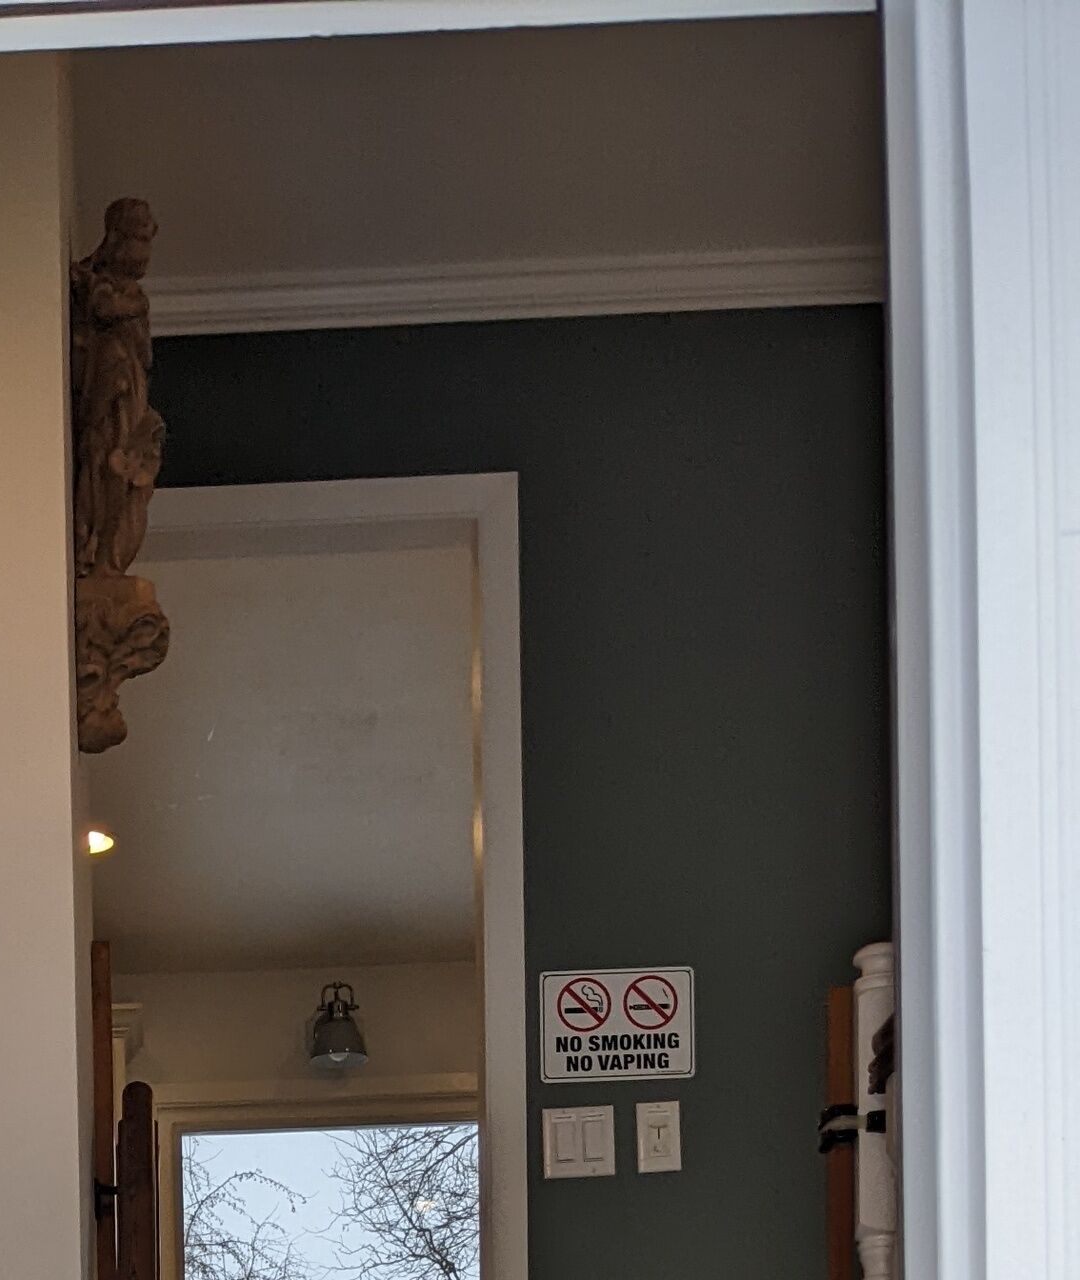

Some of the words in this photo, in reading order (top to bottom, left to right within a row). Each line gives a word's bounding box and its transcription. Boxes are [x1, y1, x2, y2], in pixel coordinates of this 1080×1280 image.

[555, 1035, 583, 1053] NO
[588, 1032, 680, 1052] SMOKING
[566, 1055, 593, 1073] NO
[598, 1052, 670, 1071] VAPING
